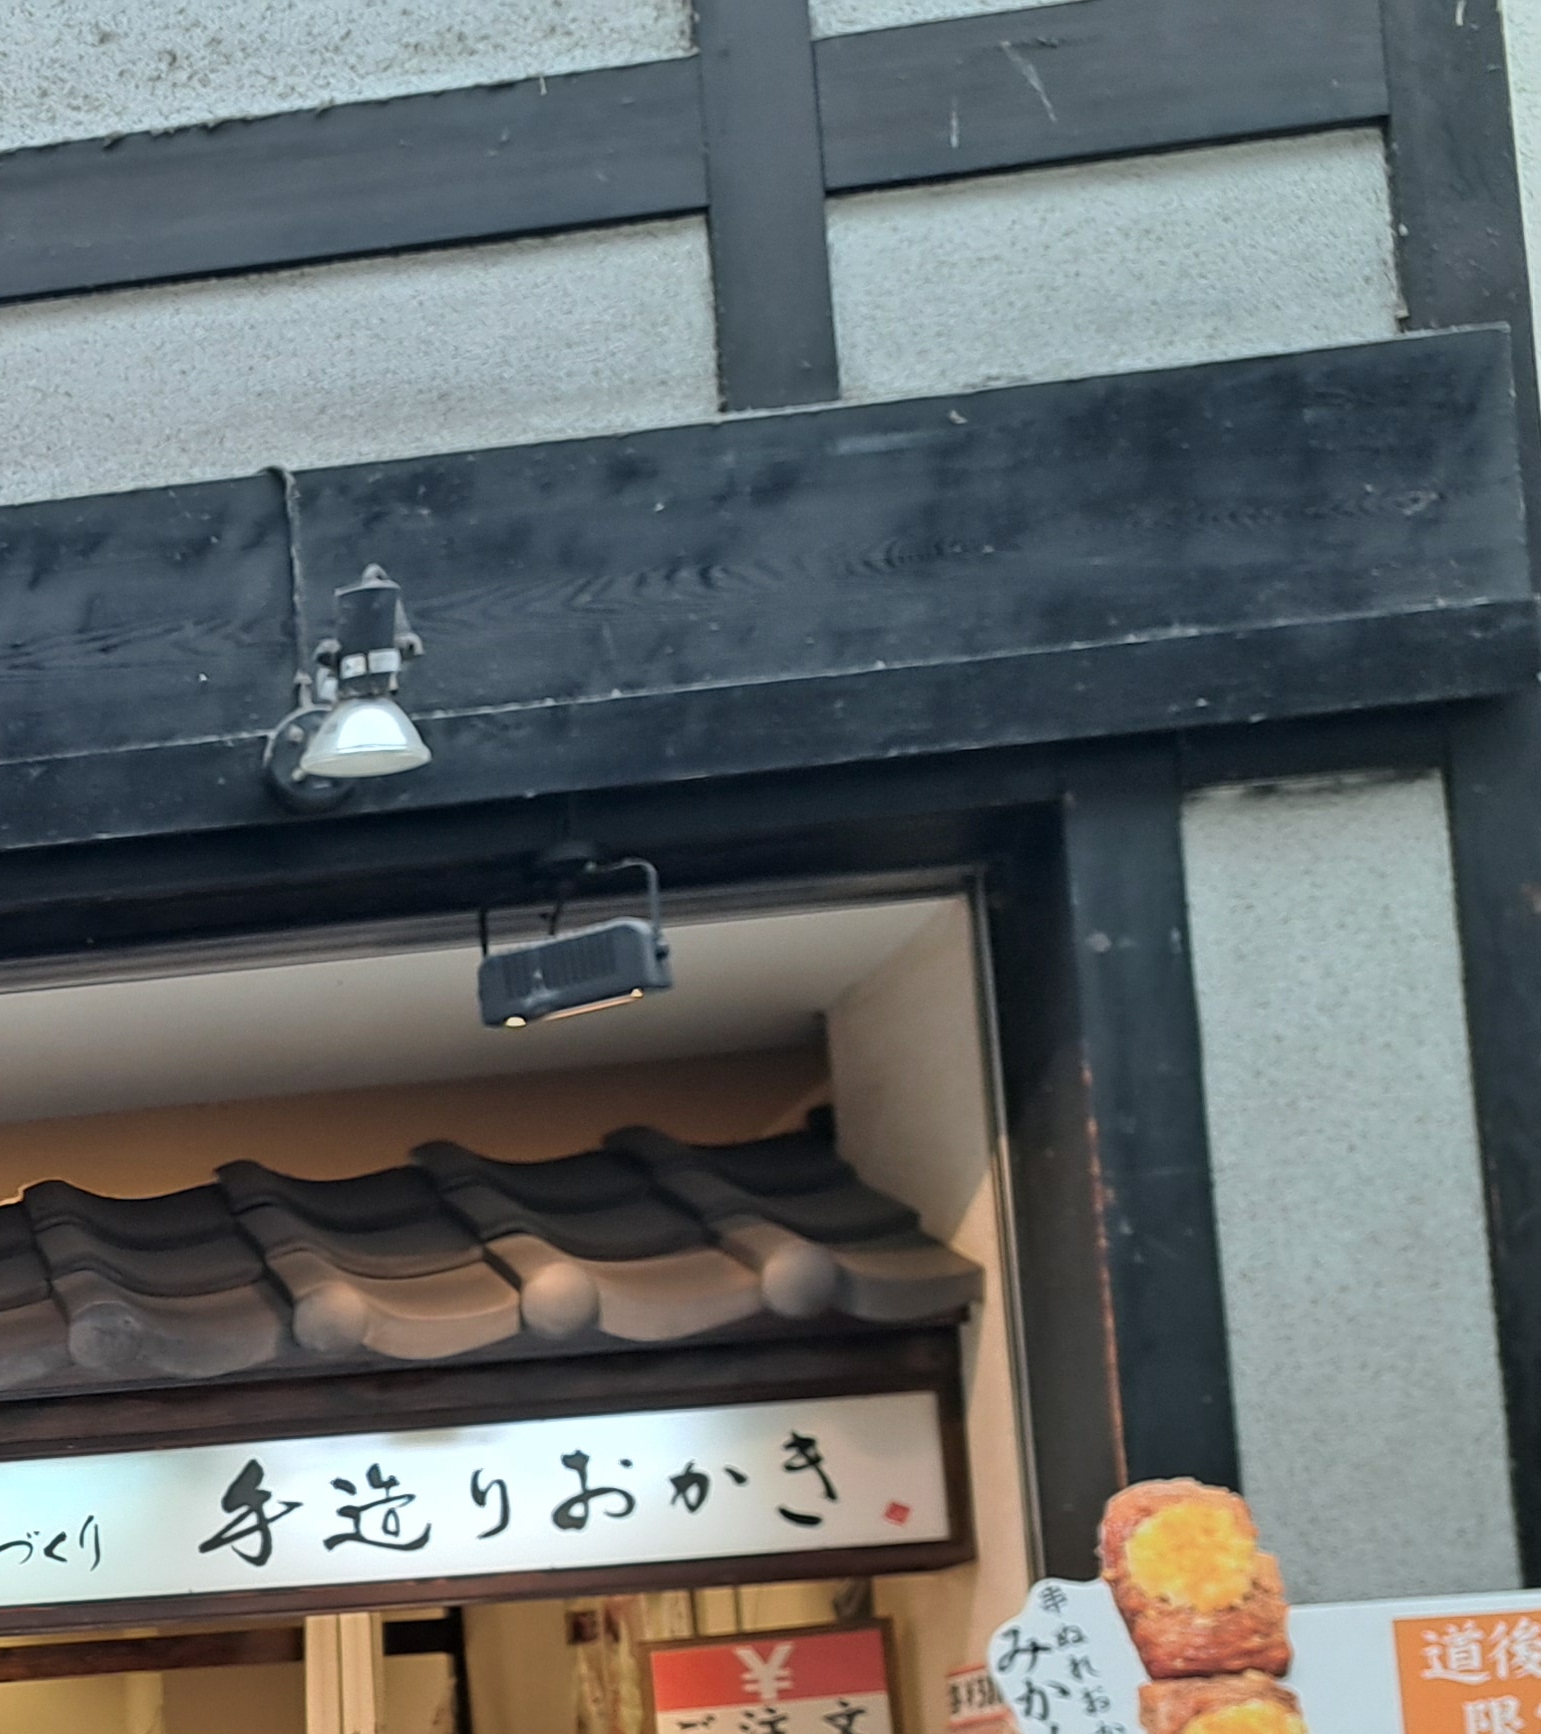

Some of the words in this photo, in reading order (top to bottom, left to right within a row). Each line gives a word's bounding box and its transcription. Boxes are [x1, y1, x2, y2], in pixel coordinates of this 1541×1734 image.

[199, 1430, 839, 1565] 手造りおかき
